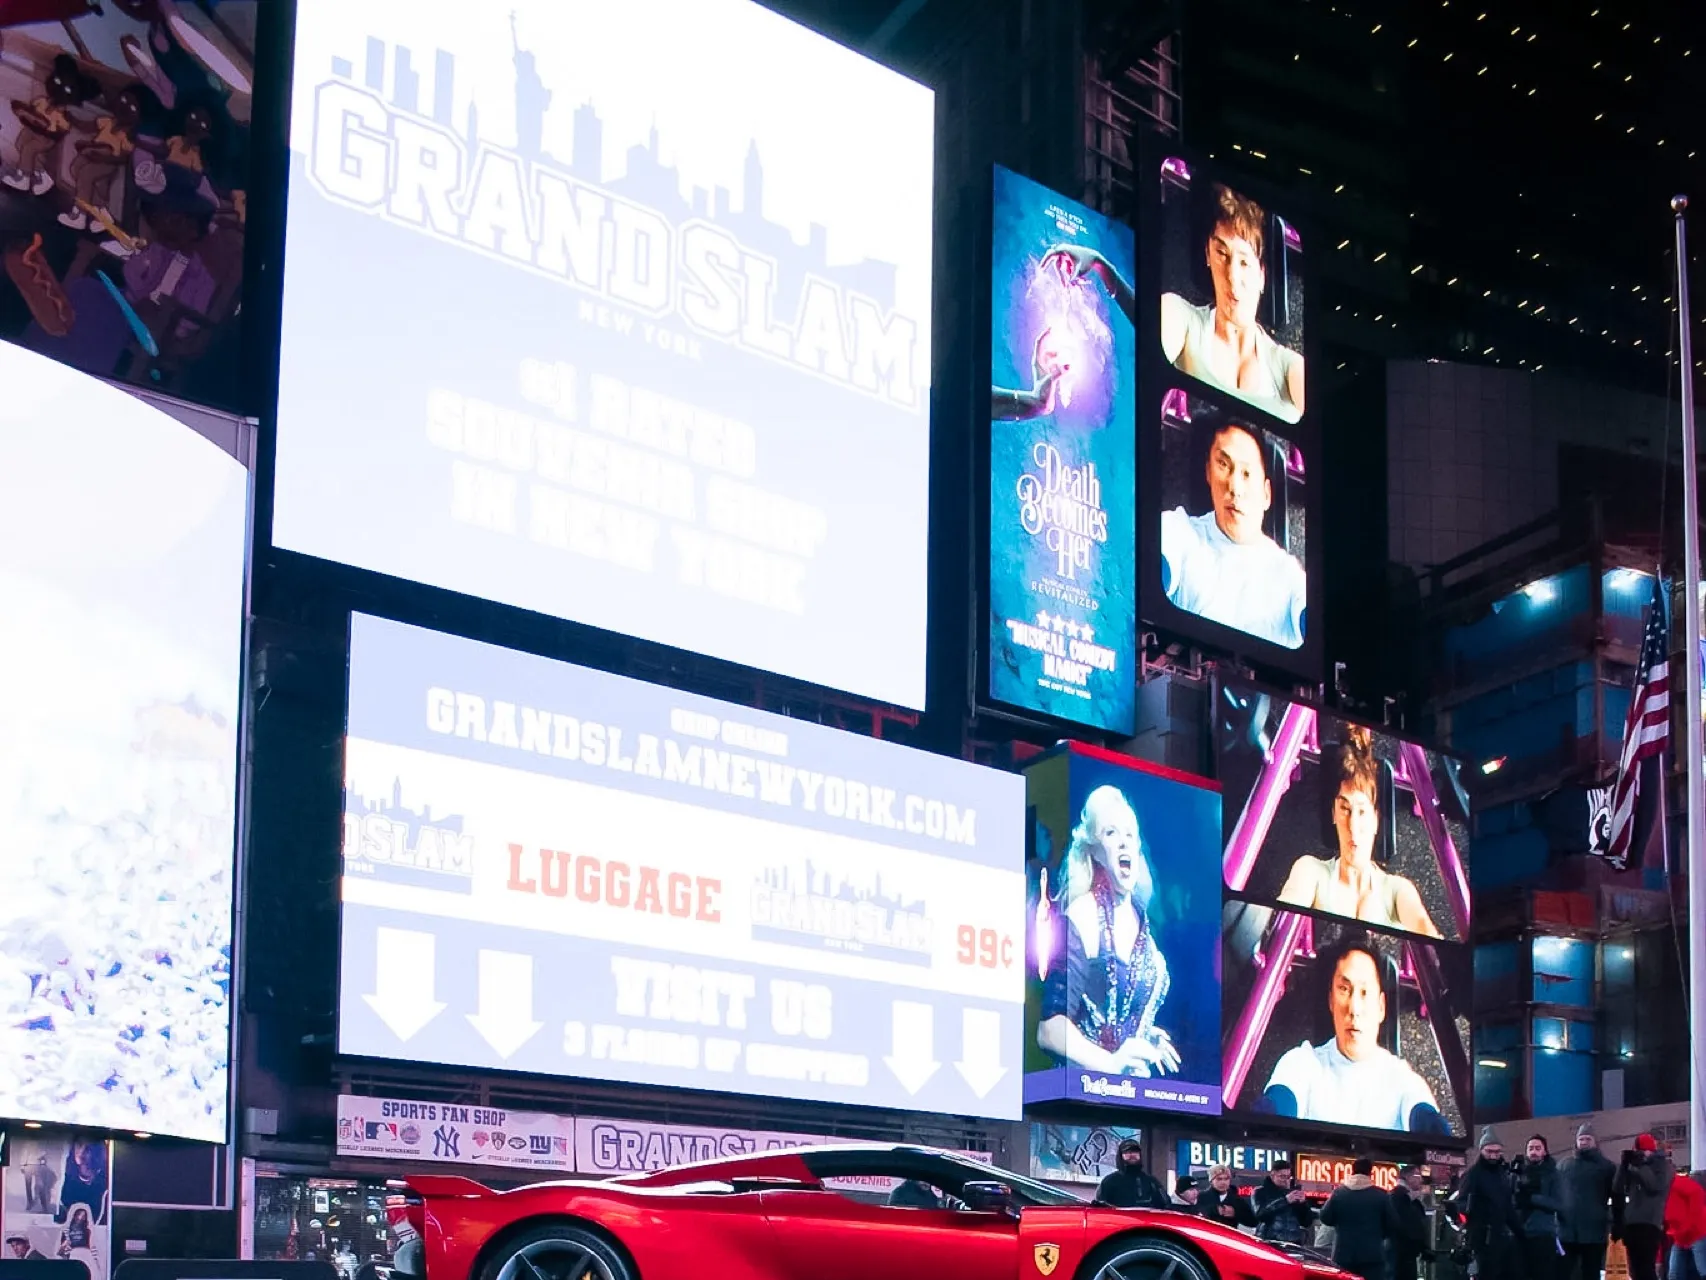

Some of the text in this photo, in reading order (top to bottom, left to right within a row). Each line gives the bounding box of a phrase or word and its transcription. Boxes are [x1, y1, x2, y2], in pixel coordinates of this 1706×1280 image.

[579, 299, 702, 361] NEW YORK
[426, 388, 696, 522] SOUVENIR
[1033, 442, 1101, 510] Death
[1016, 474, 1107, 543] Becomes
[1045, 528, 1093, 581] Her
[1031, 580, 1099, 610] REVITALIZED
[426, 686, 977, 846] GRANDSLAMNEWYORK.COM
[506, 842, 723, 923] LUGGAGE
[957, 924, 1014, 969] 99¢
[611, 955, 833, 1040] VISIT US
[382, 1101, 506, 1127] SPORTS FAN SHOP
[1190, 1141, 1245, 1170] BLUE
